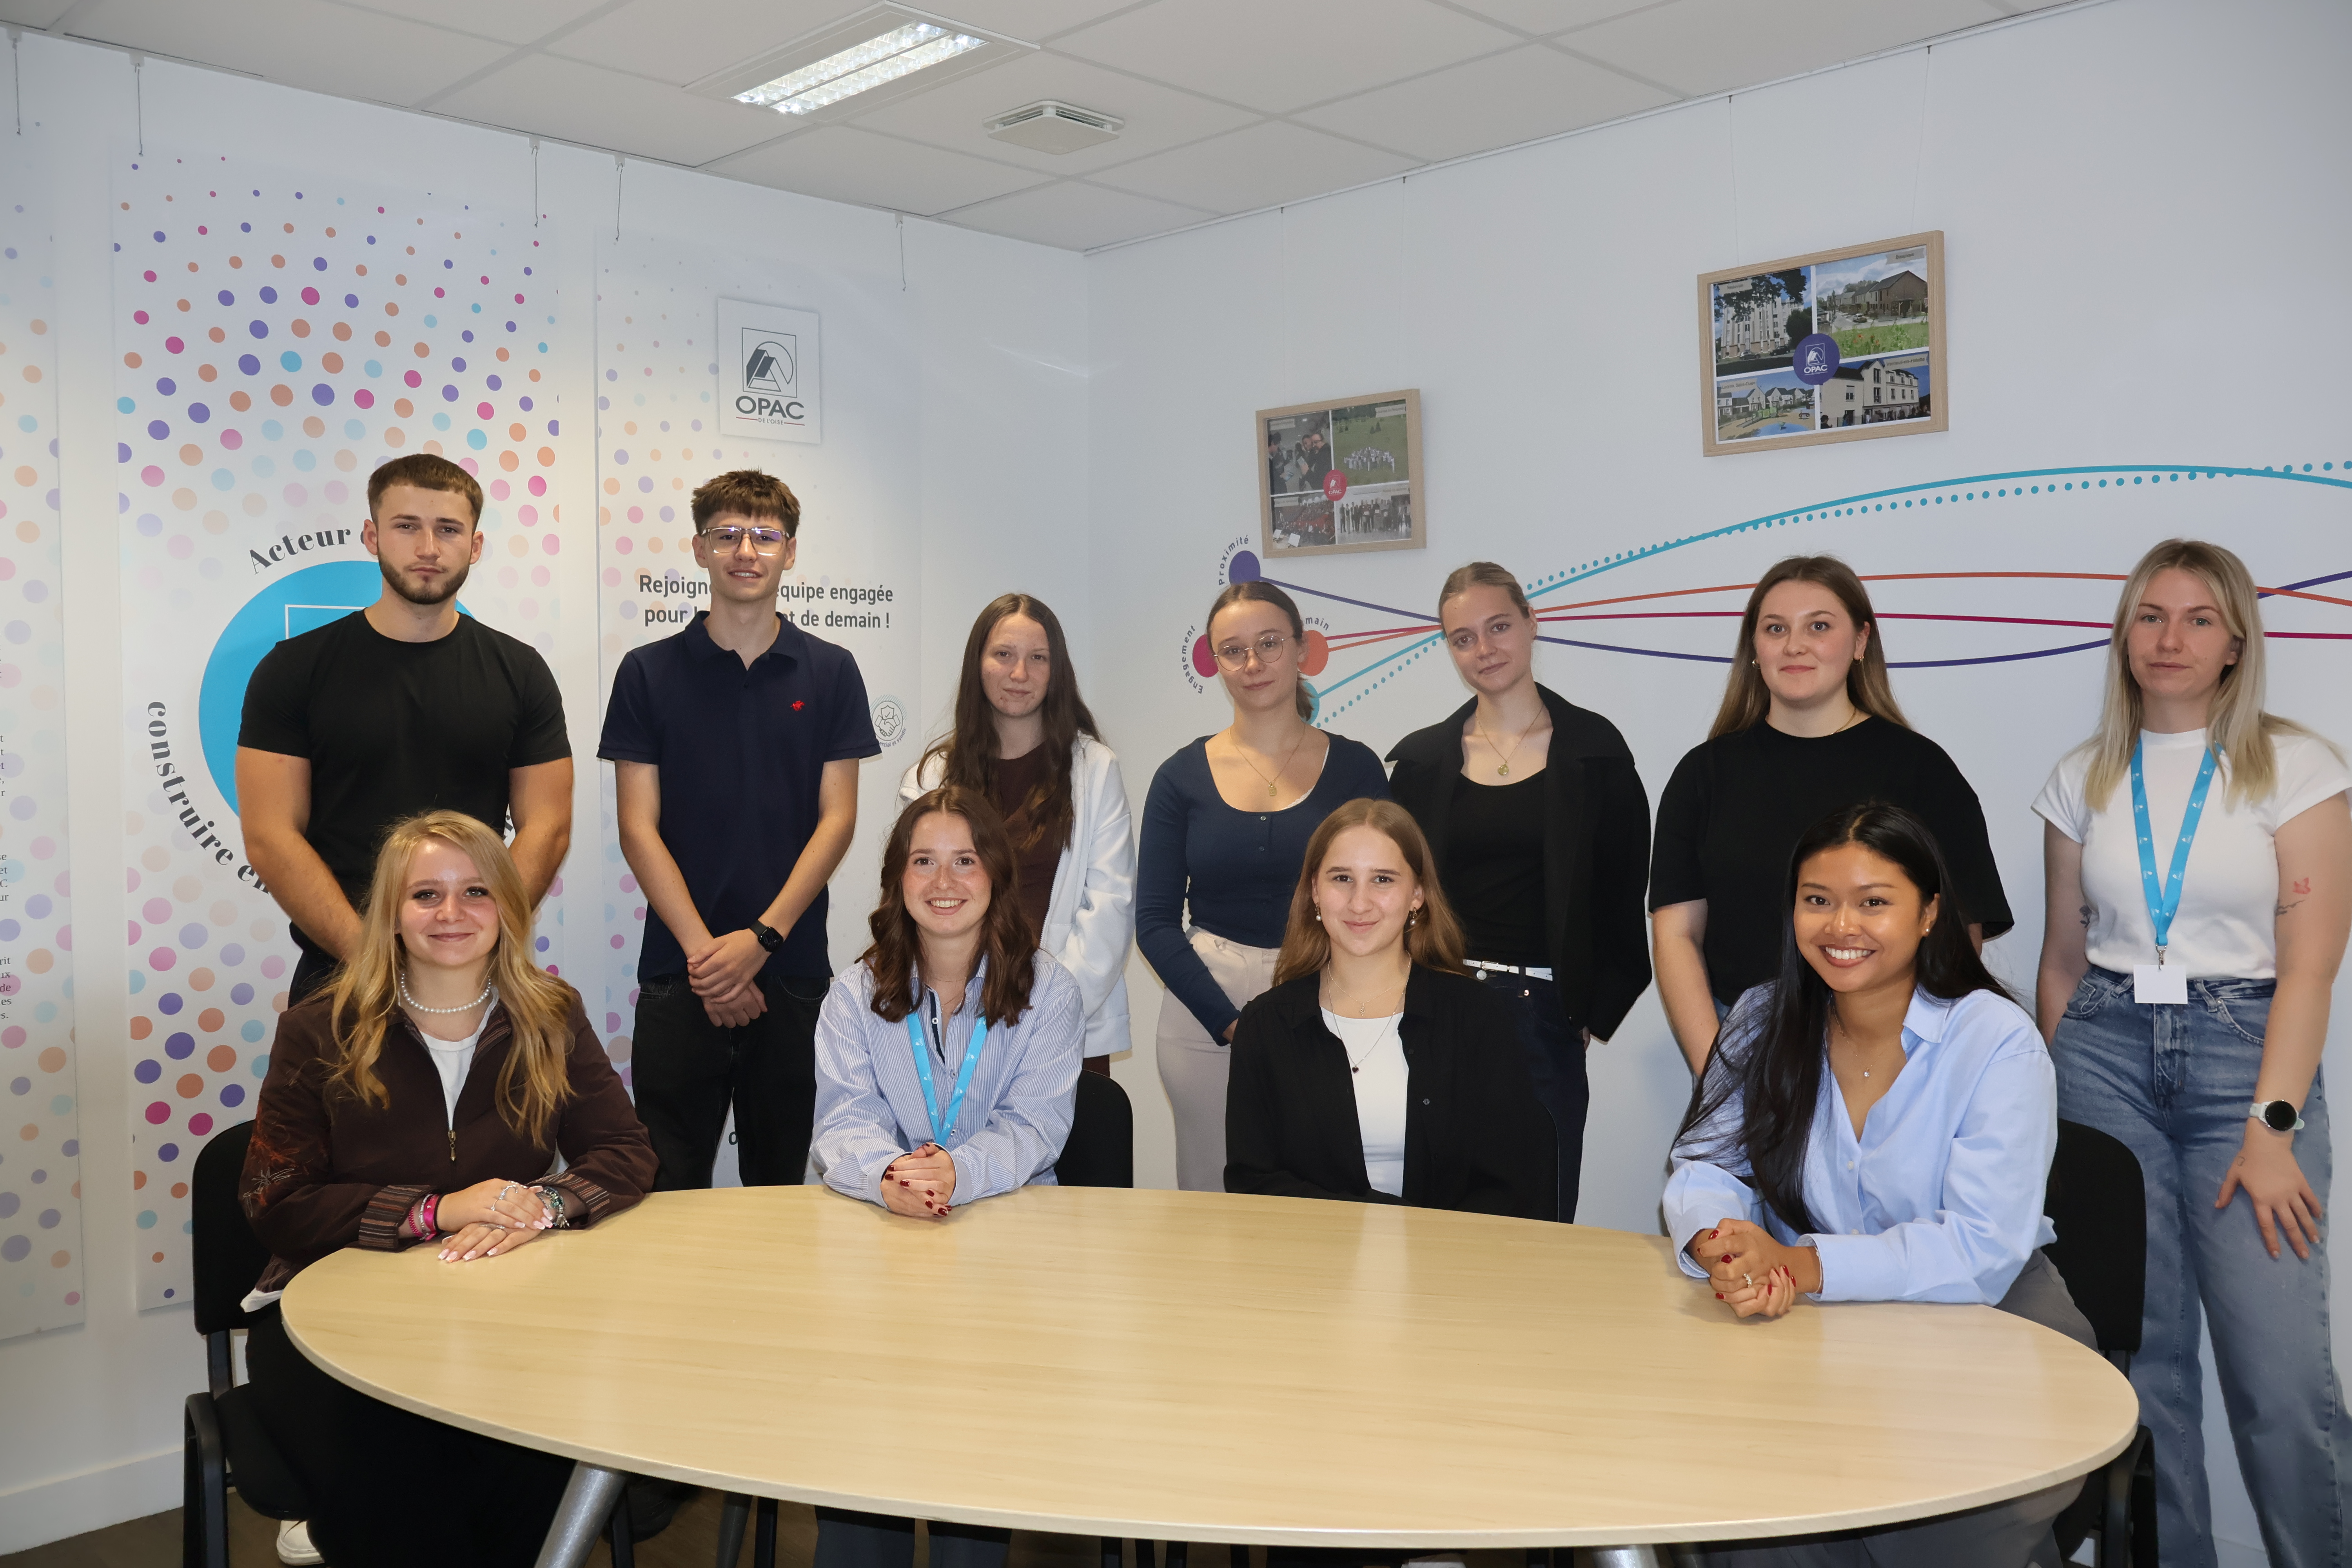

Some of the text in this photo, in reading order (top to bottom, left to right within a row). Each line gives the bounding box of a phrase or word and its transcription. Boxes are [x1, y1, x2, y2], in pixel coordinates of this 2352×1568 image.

[1804, 365, 1828, 374] OPAC
[735, 396, 804, 420] OPAC
[249, 529, 351, 575] Acteur
[1218, 534, 1249, 585] Proximité
[640, 575, 893, 605] Rejoign quipe engagée
[645, 609, 688, 627] pour
[801, 610, 819, 627] de
[825, 610, 881, 628] demain
[1305, 617, 1329, 631] main
[1181, 625, 1203, 694] Engagement
[147, 701, 234, 866] construire
